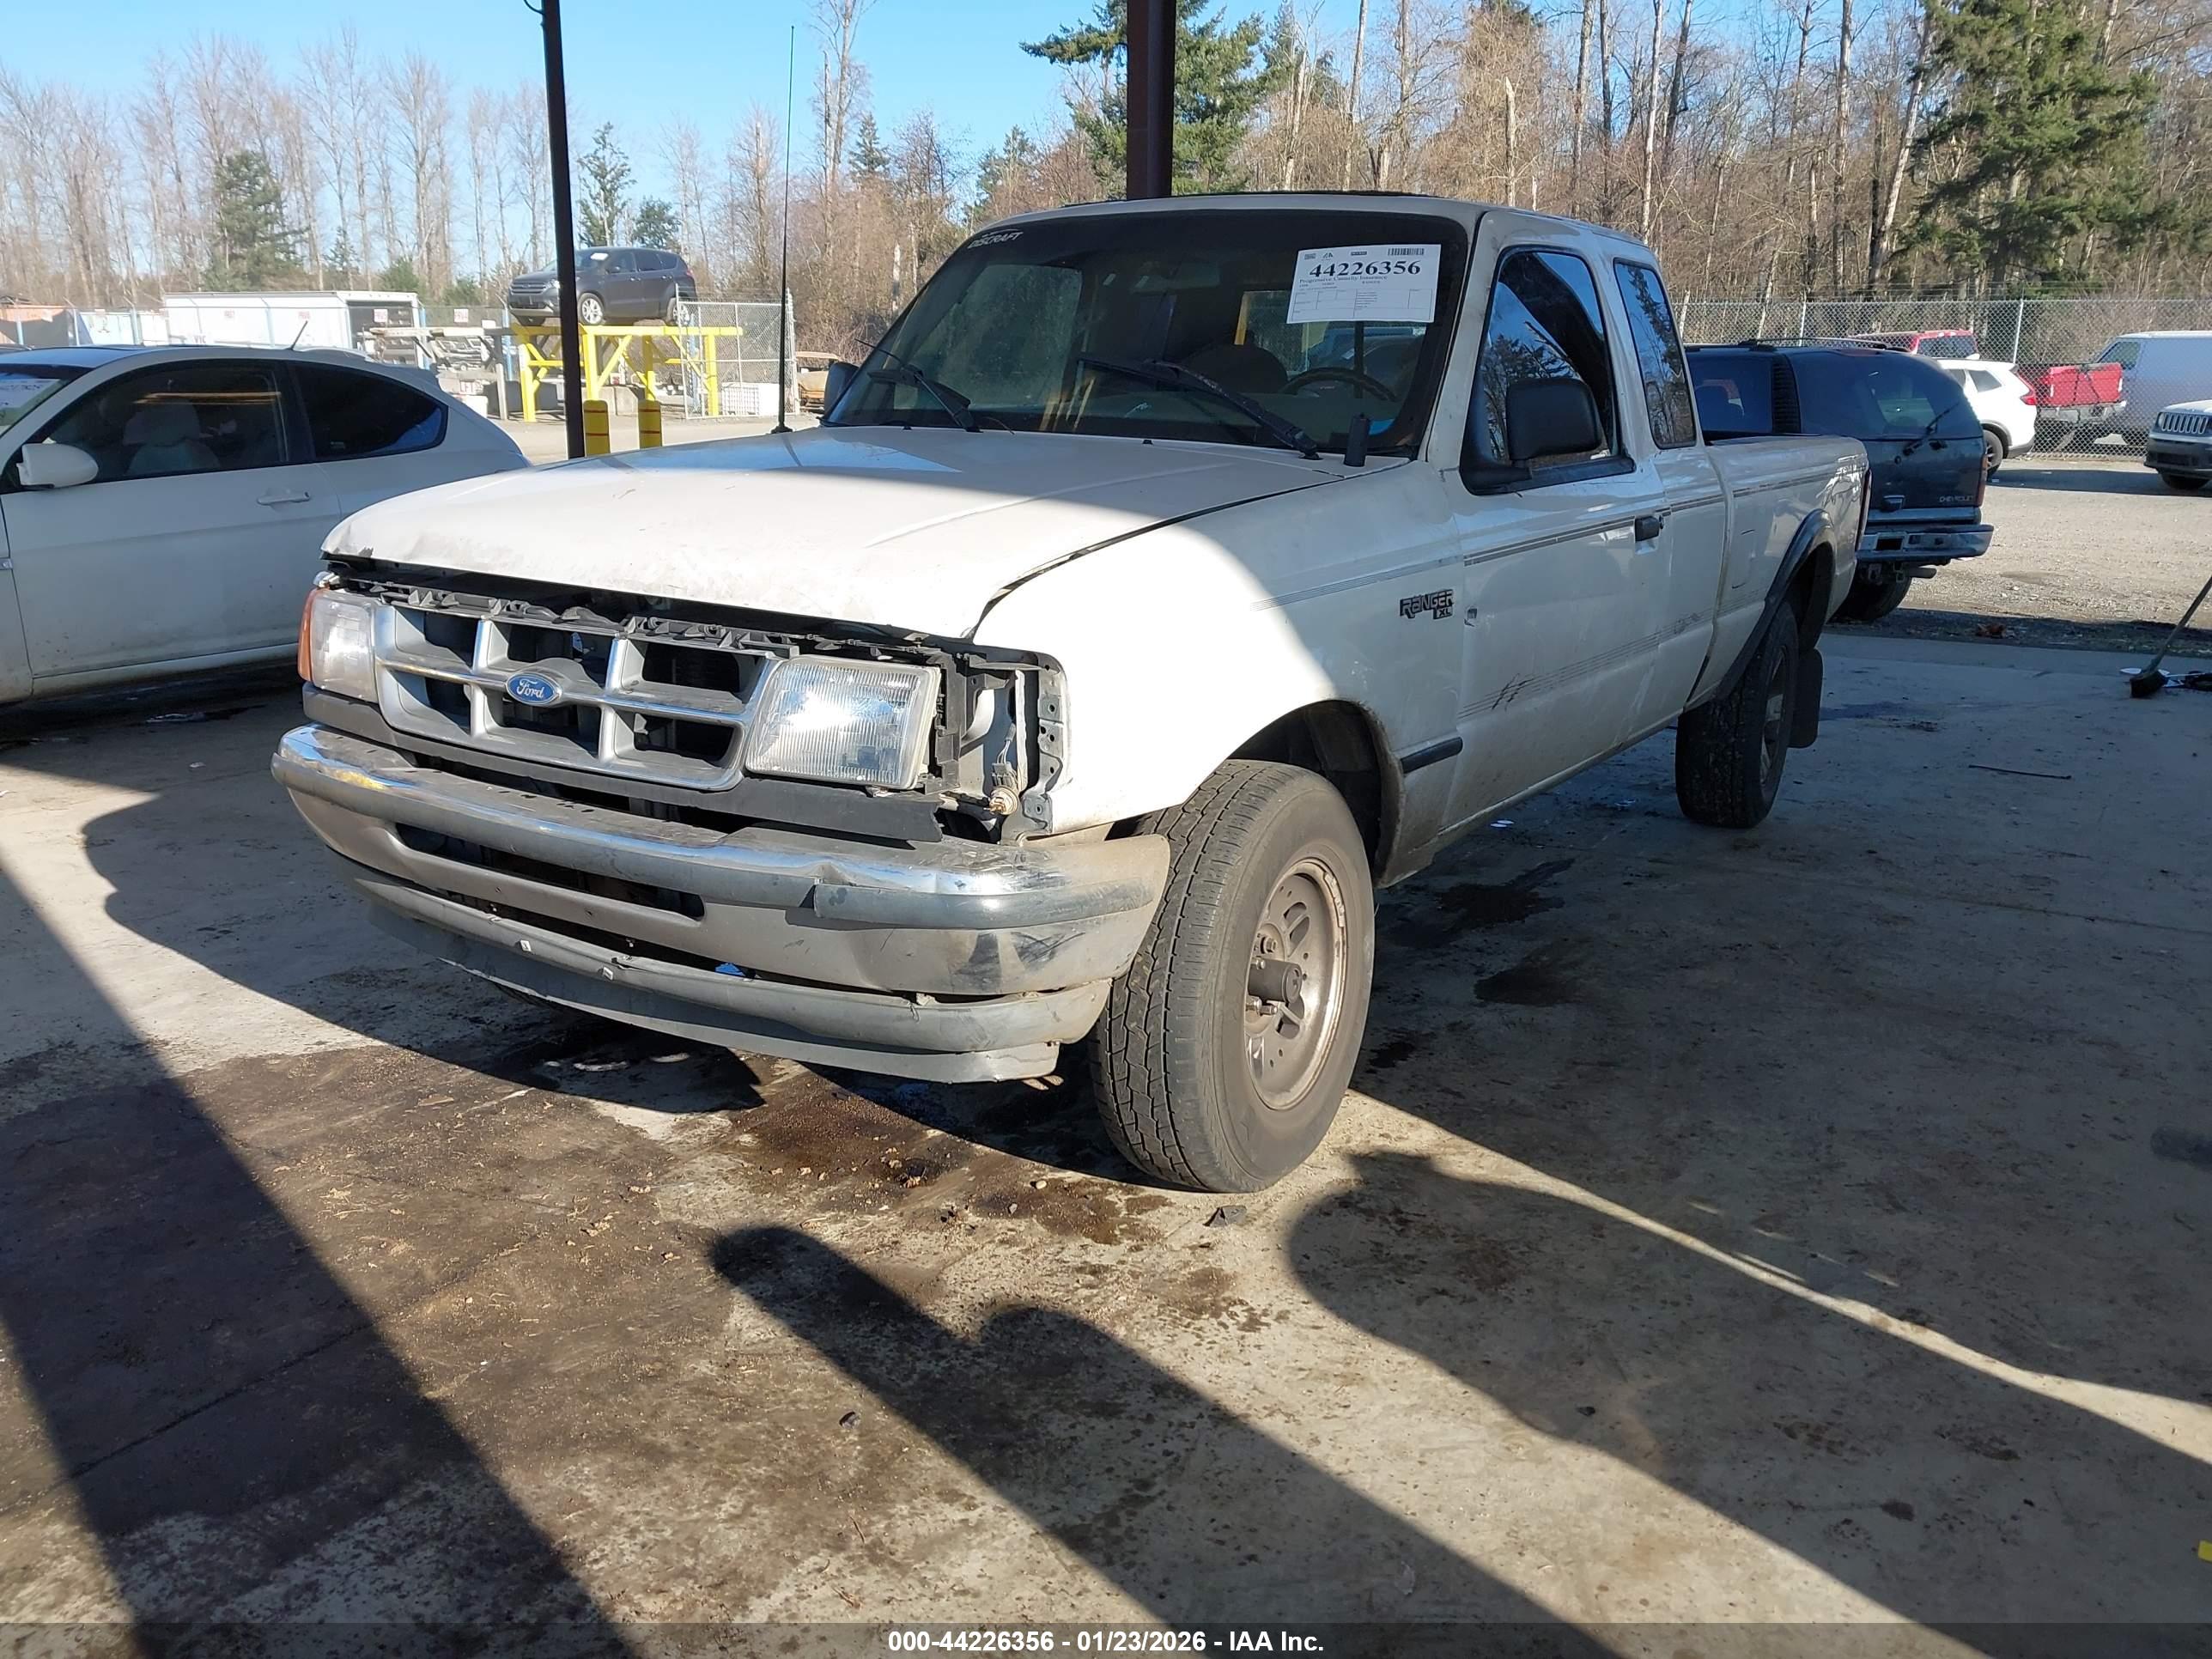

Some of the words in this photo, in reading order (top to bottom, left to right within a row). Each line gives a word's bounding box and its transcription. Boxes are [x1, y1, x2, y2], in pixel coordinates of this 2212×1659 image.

[1310, 260, 1421, 277] 44226356
[1400, 589, 1454, 619] RANGER
[517, 678, 544, 698] Ford
